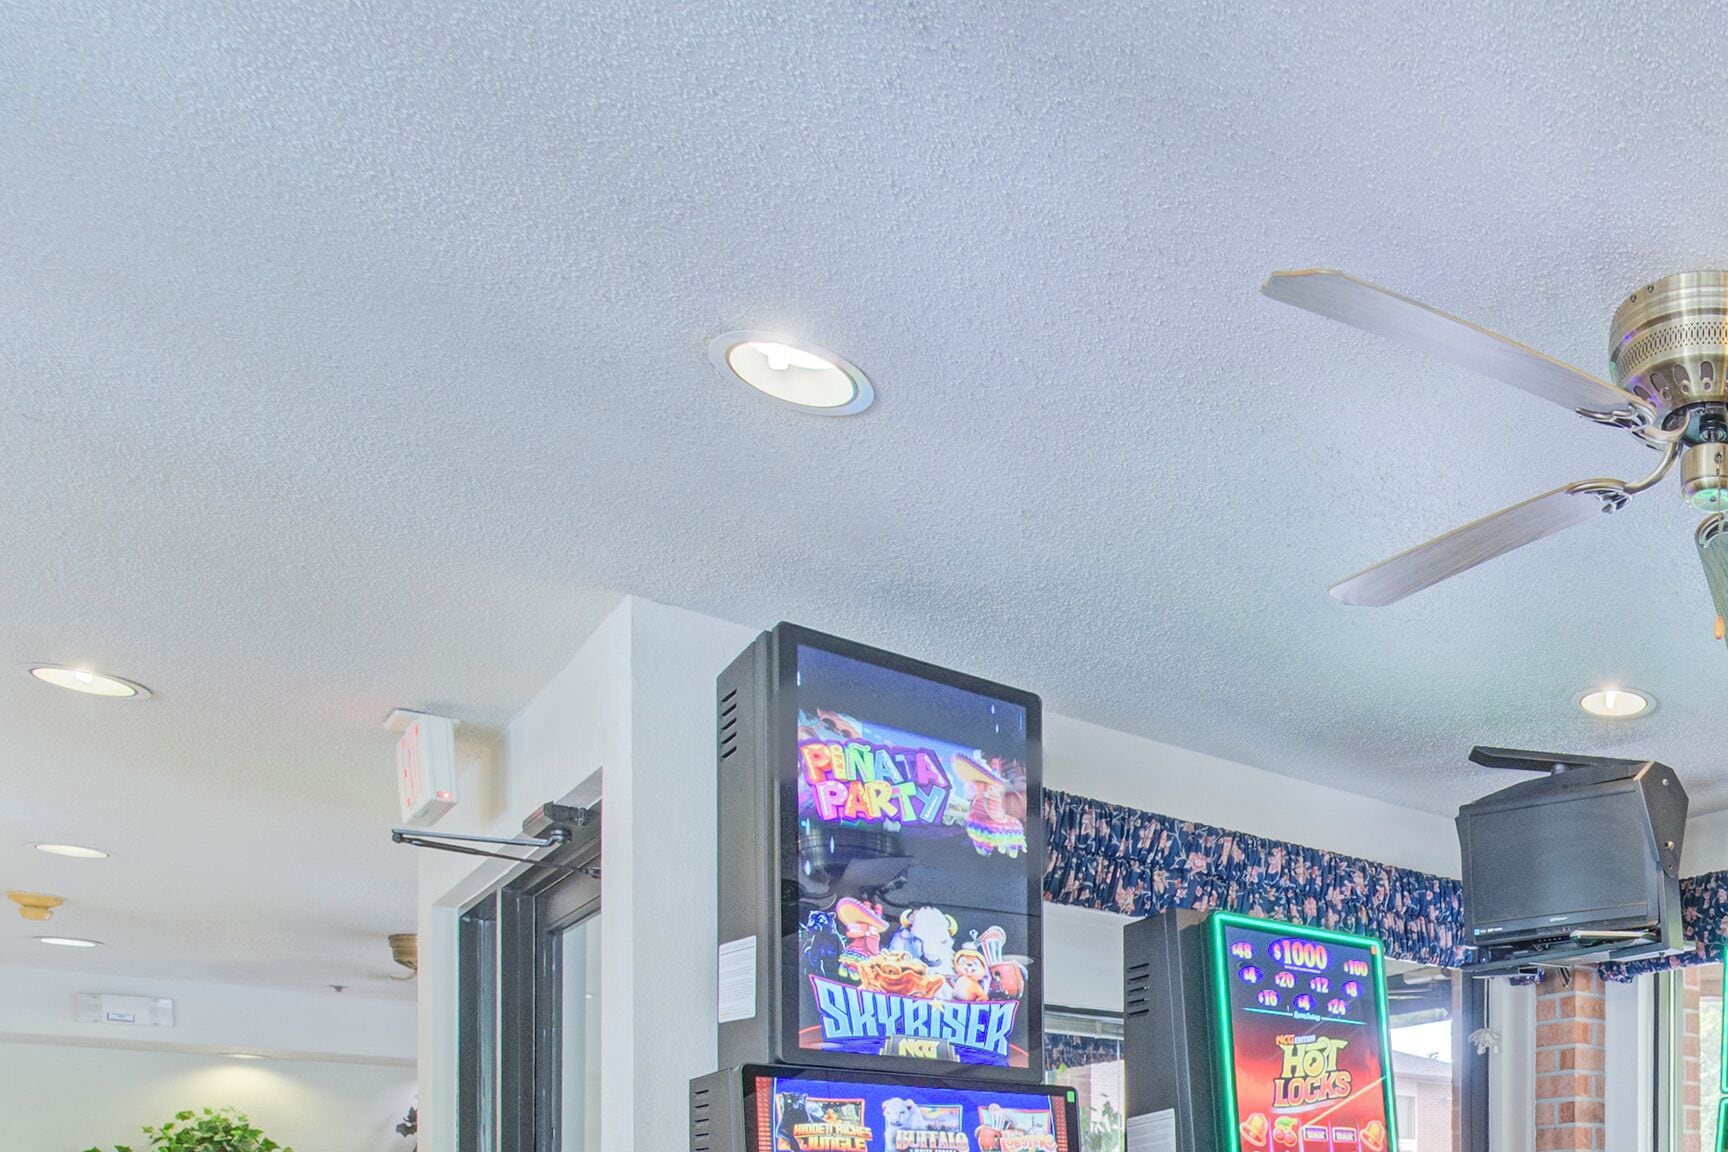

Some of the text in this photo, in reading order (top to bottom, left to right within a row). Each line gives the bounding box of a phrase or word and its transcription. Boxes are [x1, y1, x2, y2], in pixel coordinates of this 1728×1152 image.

[800, 742, 949, 787] PIÑATA
[816, 780, 946, 823] PARTY
[1231, 942, 1252, 960] $48
[1243, 966, 1257, 983] $4
[1343, 959, 1369, 977] $100
[1275, 971, 1295, 989] $20
[1310, 976, 1329, 993] $12
[1258, 989, 1278, 1007] $16
[1327, 998, 1346, 1016] $24
[814, 977, 1018, 1056] SKYRISER
[1279, 1036, 1349, 1078] HOT
[1273, 1070, 1352, 1108] LOCKS
[793, 1123, 833, 1137] HIDDEN
[800, 1135, 868, 1152] JUNGLE
